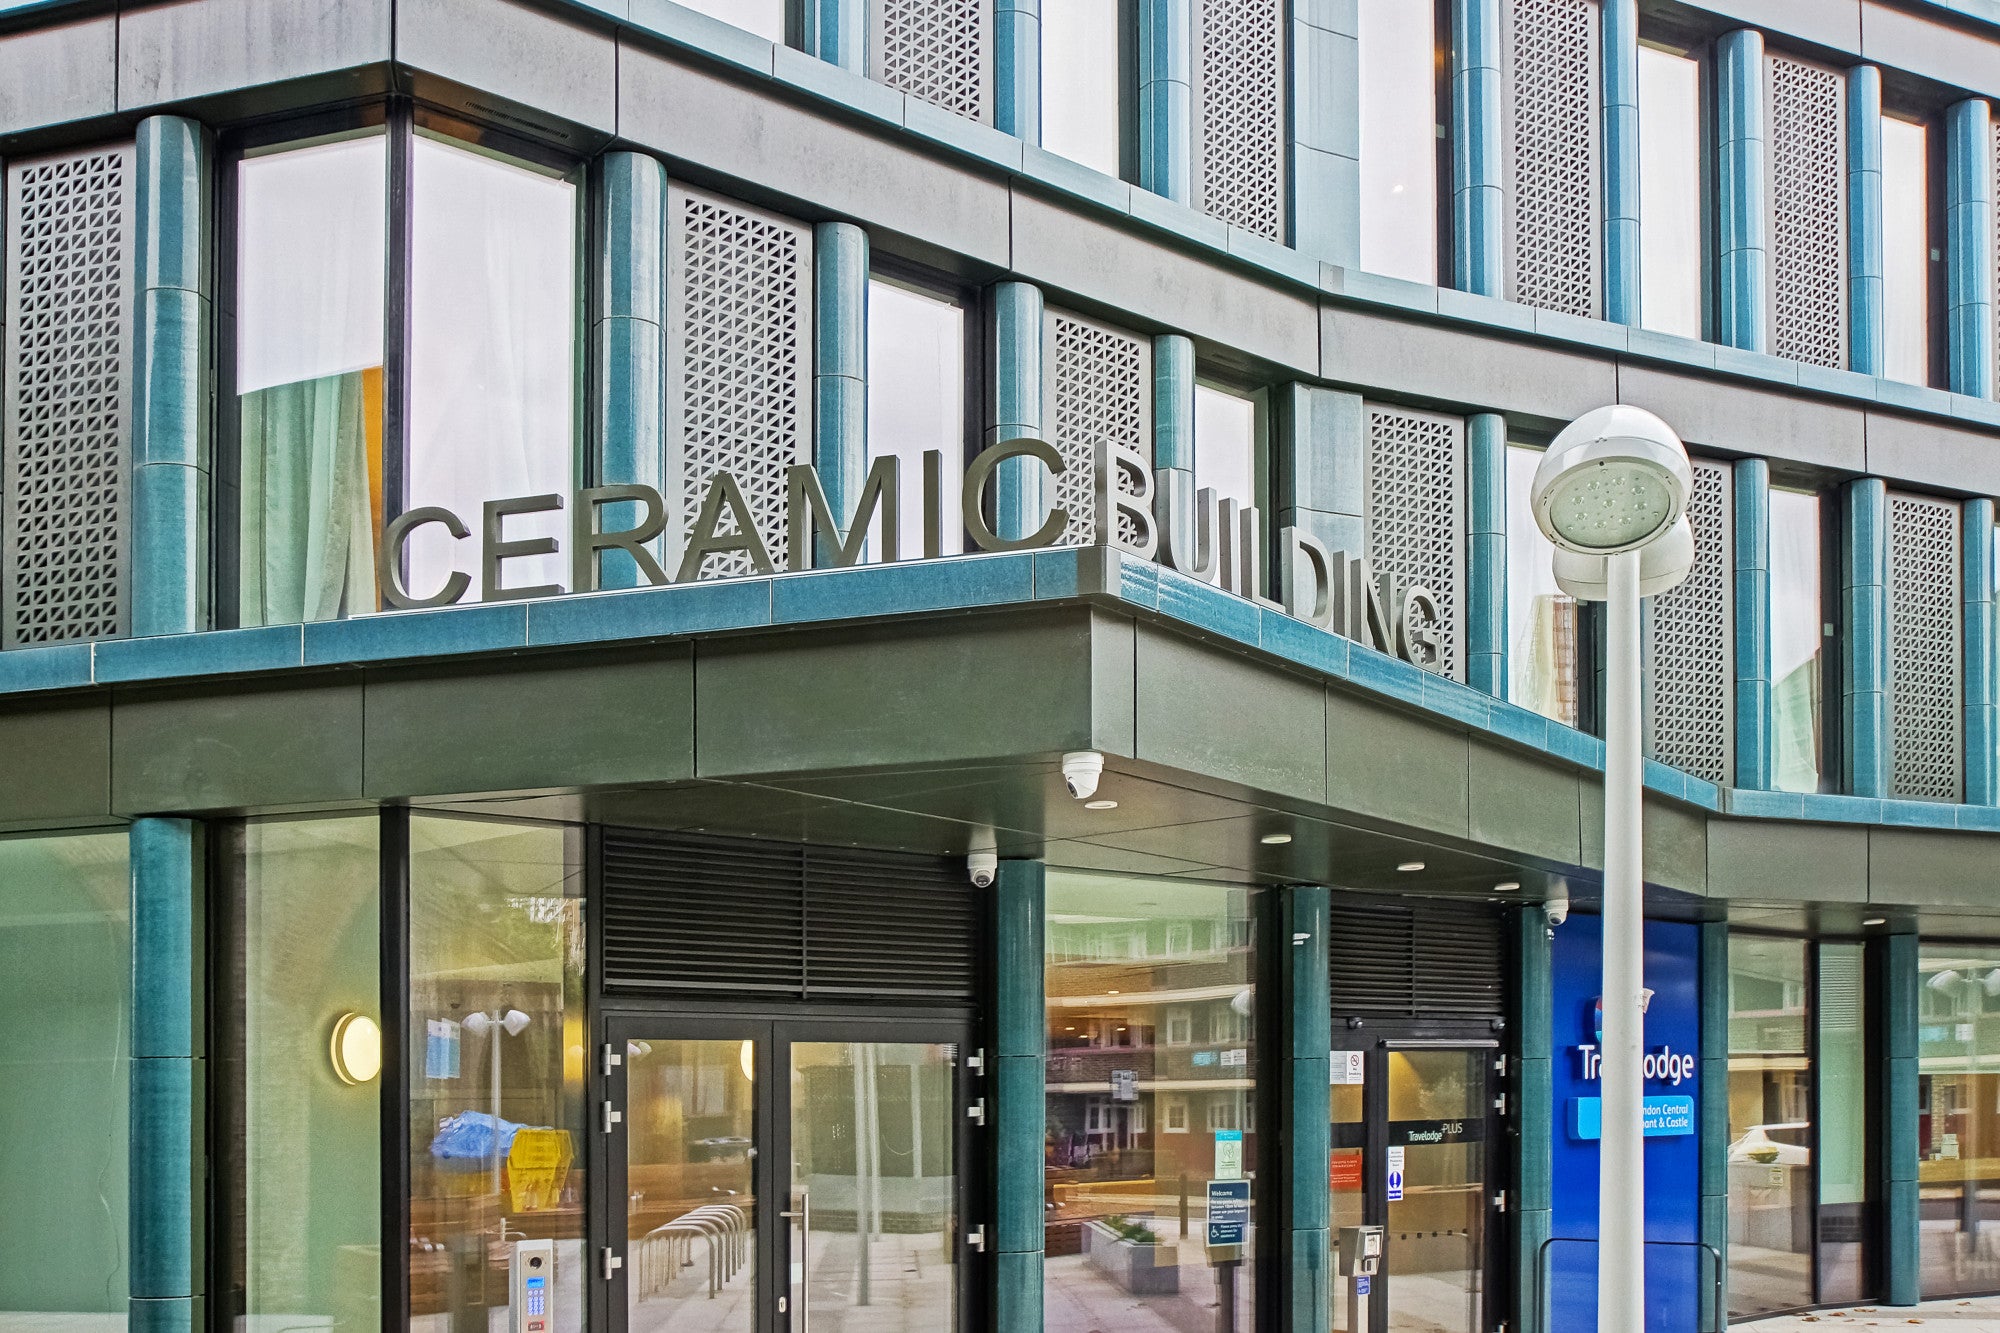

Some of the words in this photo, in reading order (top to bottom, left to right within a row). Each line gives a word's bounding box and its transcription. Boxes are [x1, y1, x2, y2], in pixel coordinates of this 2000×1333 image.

[380, 437, 1068, 611] CERAMIC
[1094, 439, 1442, 672] BUILDING
[1578, 1044, 1694, 1086] Trodge
[1662, 1104, 1688, 1115] Central
[1659, 1116, 1665, 1128] &
[1666, 1116, 1688, 1128] Castle
[1408, 1130, 1443, 1143] Travelodge
